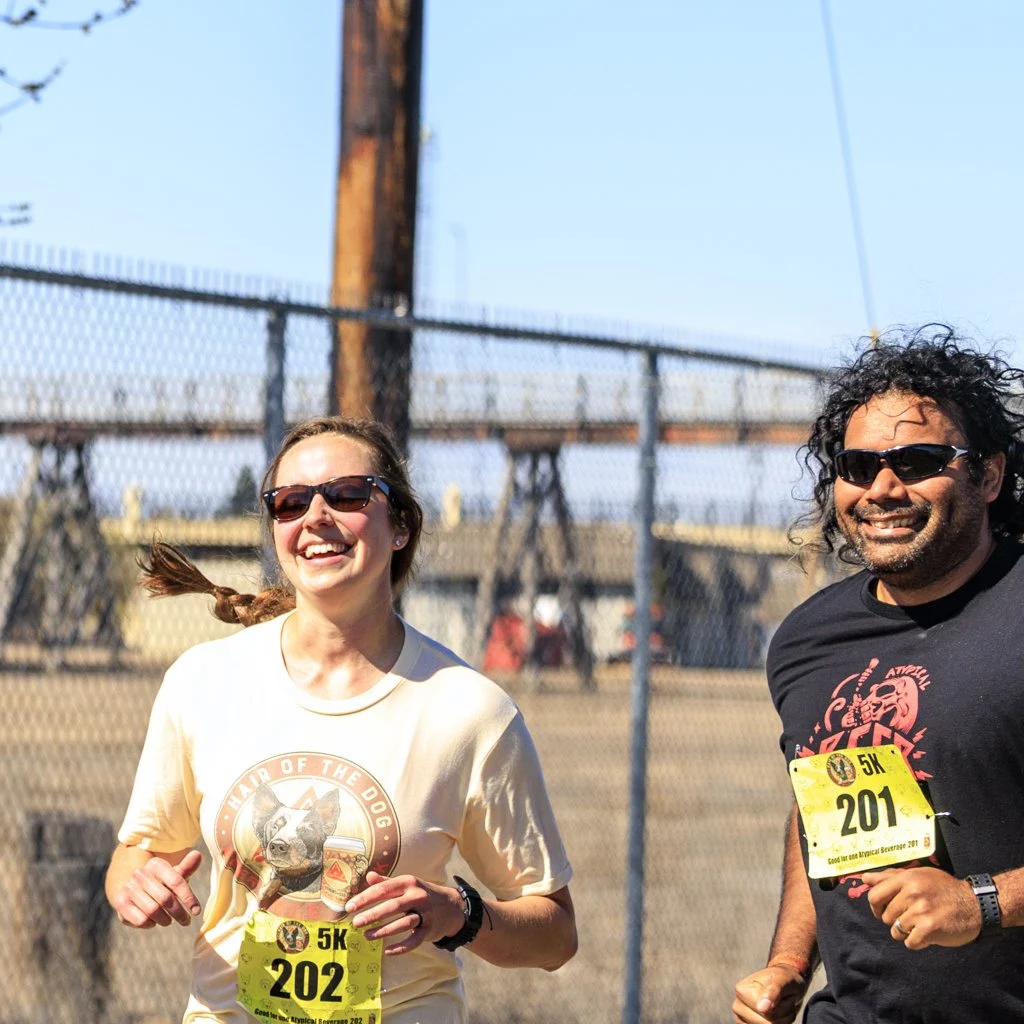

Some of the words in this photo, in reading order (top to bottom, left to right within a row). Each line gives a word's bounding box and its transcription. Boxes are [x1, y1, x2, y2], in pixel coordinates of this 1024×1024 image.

[885, 664, 931, 691] ATYPICAL
[858, 752, 887, 777] 5K
[227, 767, 271, 811] HAIR
[280, 757, 308, 775] OF
[322, 759, 362, 786] THE
[361, 786, 393, 829] DOG
[836, 785, 898, 837] 201
[828, 857, 841, 865] Good
[859, 848, 880, 858] Atypical
[881, 843, 906, 853] Beverage
[908, 840, 918, 848] 201
[317, 928, 348, 950] 5K
[269, 958, 344, 1002] 202
[255, 1008, 269, 1018] Good
[291, 1016, 317, 1024] Atypical
